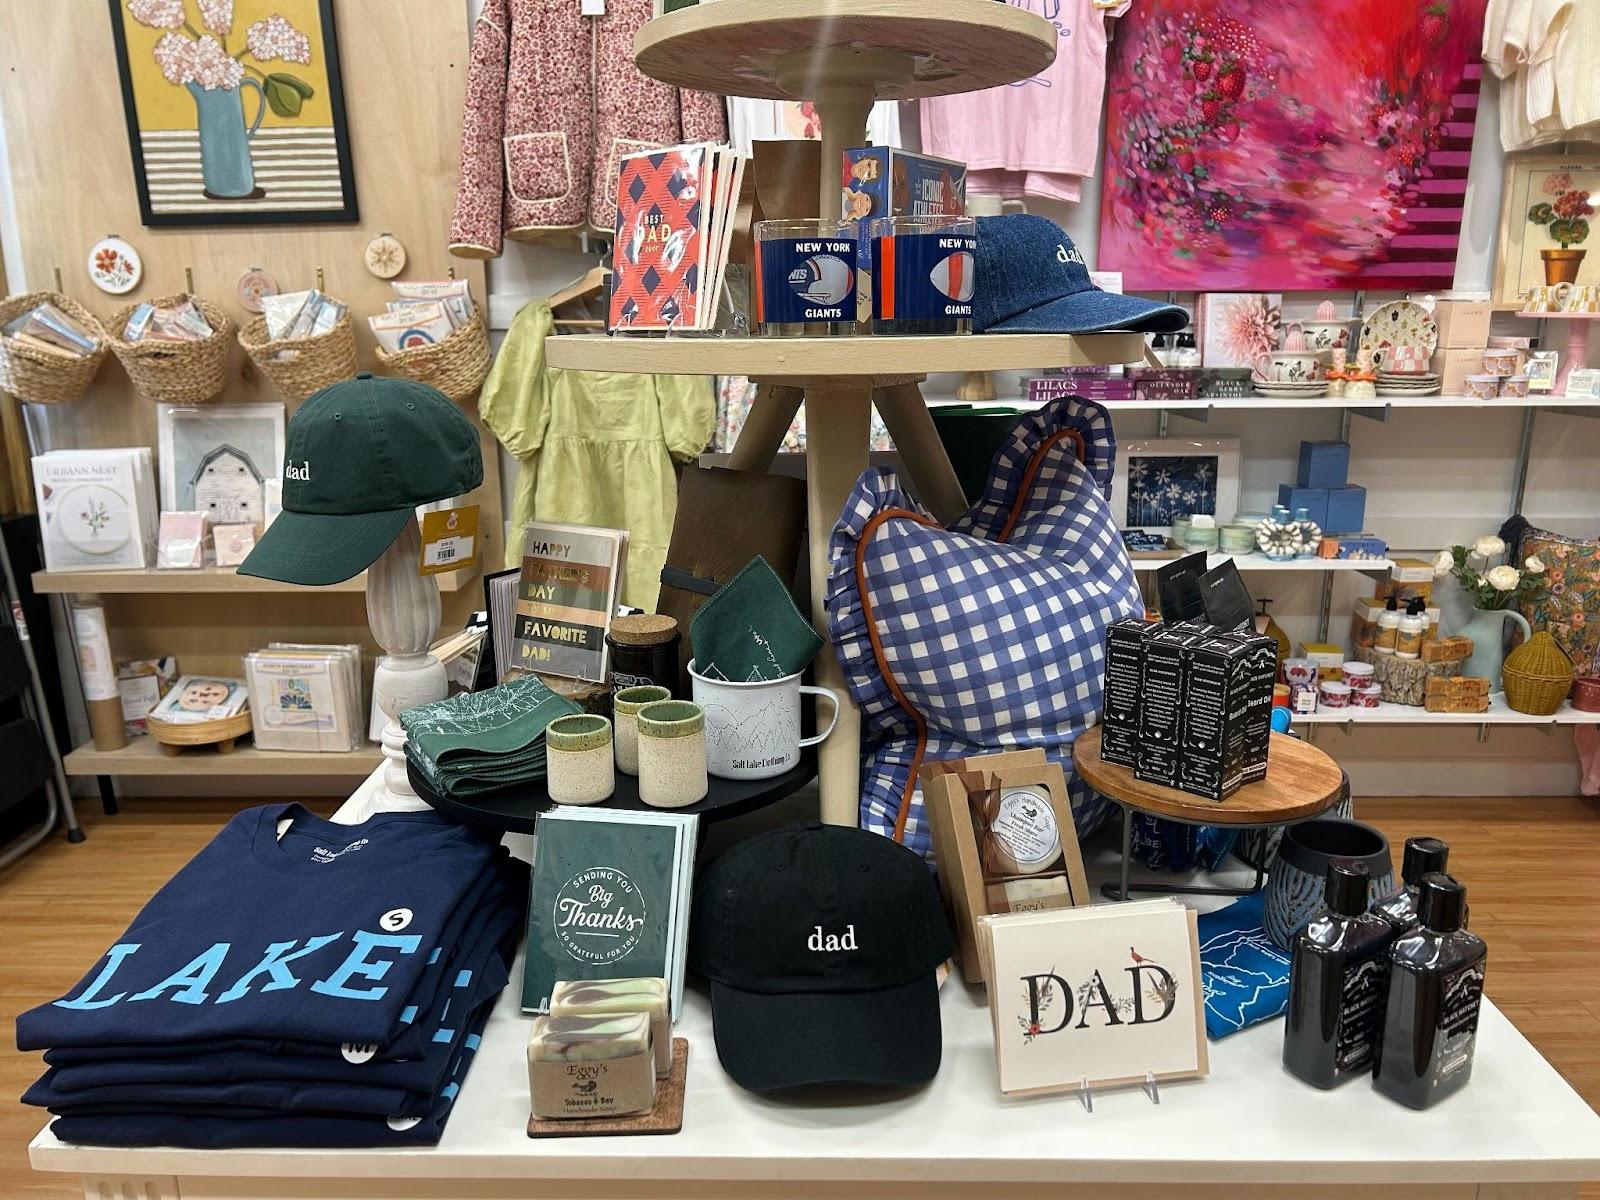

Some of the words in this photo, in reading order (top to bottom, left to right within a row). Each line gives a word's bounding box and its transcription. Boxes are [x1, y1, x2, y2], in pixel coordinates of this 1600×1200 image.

[922, 178, 945, 204] ICONIC
[644, 214, 665, 225] BEST
[796, 242, 822, 253] NEW
[827, 242, 851, 253] YORK
[939, 238, 962, 249] NEW
[1056, 243, 1085, 265] dad
[804, 308, 842, 319] GIANTS
[944, 304, 972, 315] GIANTS
[1036, 381, 1078, 391] LILACS
[91, 466, 118, 477] NEST
[285, 459, 311, 481] dad
[532, 540, 571, 558] HAPPY
[527, 583, 556, 600] DAY
[523, 620, 588, 645] FAVORITE
[521, 644, 552, 661] DAD!
[1229, 708, 1242, 721] Beard
[732, 759, 745, 769] Salt
[746, 759, 762, 769] Lake
[762, 756, 785, 767] Clothing
[572, 871, 614, 889] SENDING
[616, 876, 633, 893] YOU
[588, 884, 614, 909] Big
[388, 911, 404, 927] S
[558, 897, 644, 932] Thanks
[560, 931, 570, 942] SO
[568, 942, 604, 960] GRATEFUL
[606, 948, 621, 958] FOR
[621, 936, 635, 950] YOU
[806, 924, 859, 952] dad
[52, 928, 424, 1011] LAKE
[1019, 963, 1177, 1037] DAD
[1458, 999, 1481, 1016] HATCHET
[566, 1063, 608, 1080] Eggy's
[562, 1106, 598, 1114] Handmade
[599, 1105, 617, 1114] Soap
[564, 1098, 592, 1106] Tobacco
[593, 1098, 600, 1106] &
[600, 1096, 614, 1105] Bay
